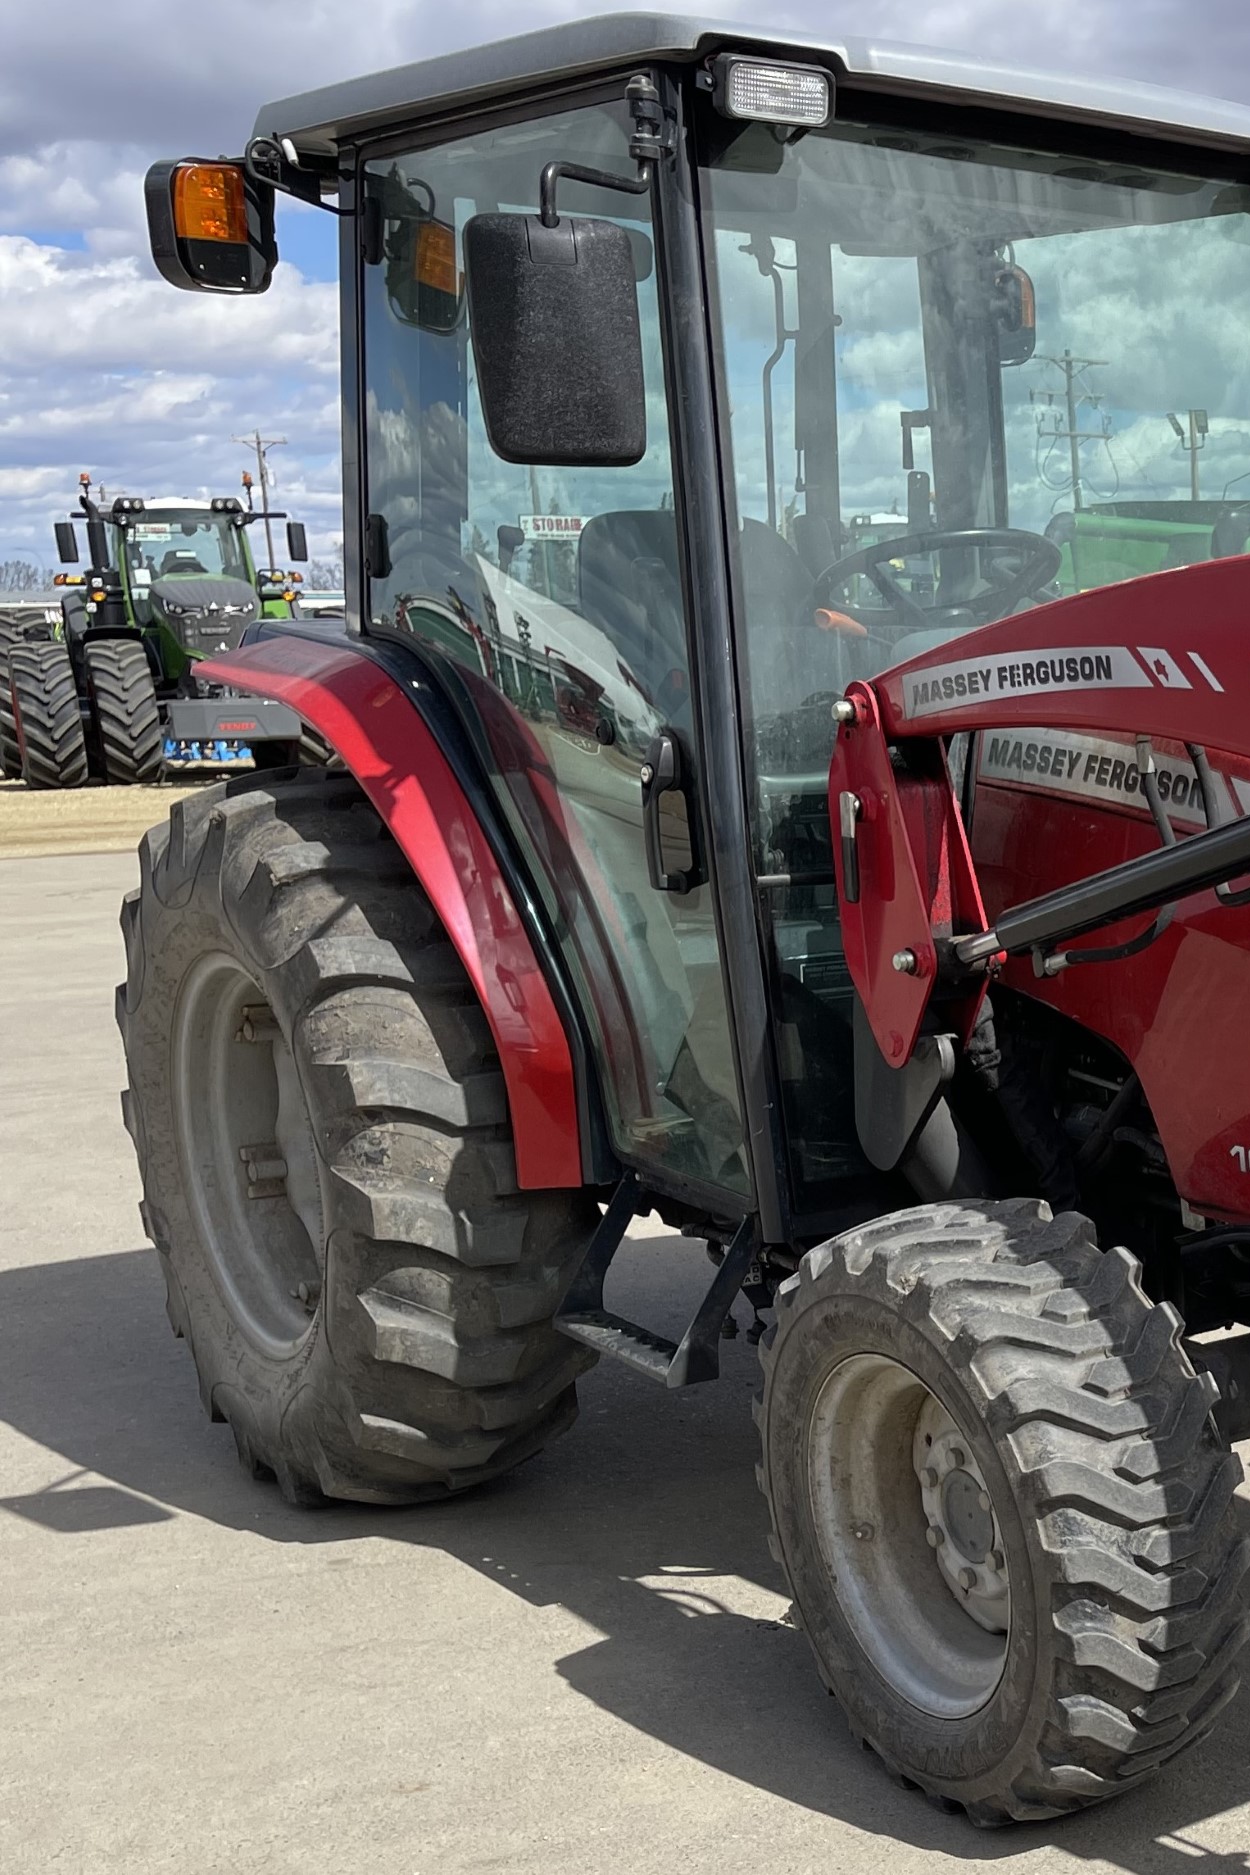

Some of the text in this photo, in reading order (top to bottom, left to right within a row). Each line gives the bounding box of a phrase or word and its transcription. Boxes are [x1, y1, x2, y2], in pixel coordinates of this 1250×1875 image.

[911, 655, 1112, 706] MASSEY FERGUSON
[988, 737, 1206, 812] MASSEY FERGSON
